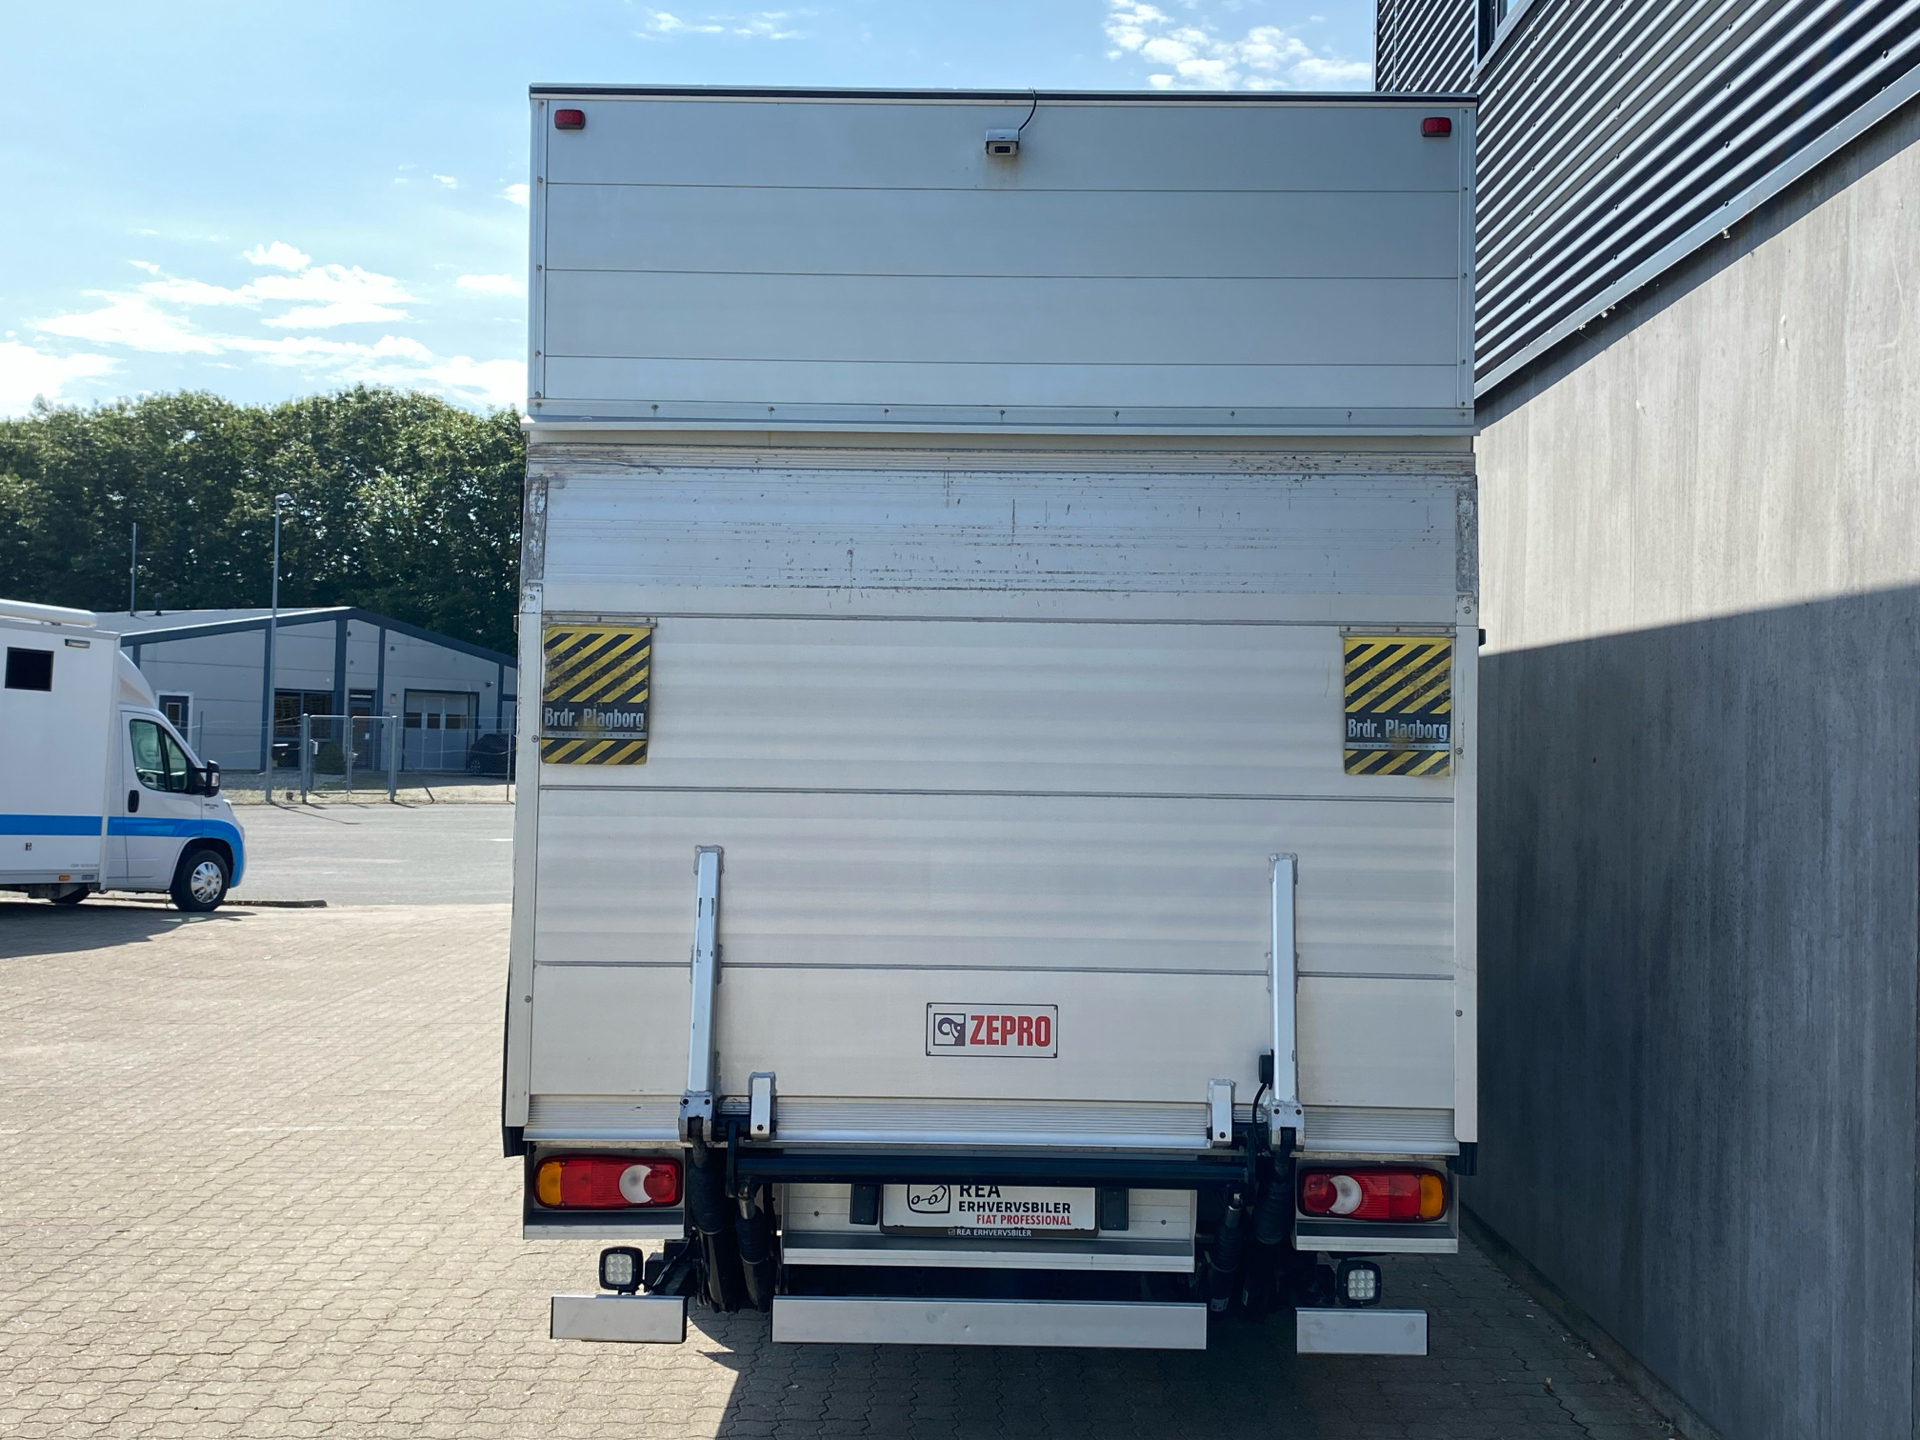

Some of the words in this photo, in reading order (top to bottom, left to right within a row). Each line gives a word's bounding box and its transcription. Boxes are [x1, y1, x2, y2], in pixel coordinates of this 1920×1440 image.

[544, 707, 579, 727] Brdr.
[583, 708, 645, 730] Plagborg
[1347, 718, 1381, 738] Brdr.
[1385, 719, 1448, 742] Plagborg
[969, 1015, 1051, 1047] ZEPRO
[959, 1184, 1001, 1199] REA
[958, 1201, 1071, 1214] ERHVERVSBILER
[976, 1214, 997, 1225] FIAT
[1000, 1214, 1072, 1226] PROFESSIONAL
[956, 1228, 971, 1236] REA
[973, 1228, 1032, 1237] ERHVERVSBILER
